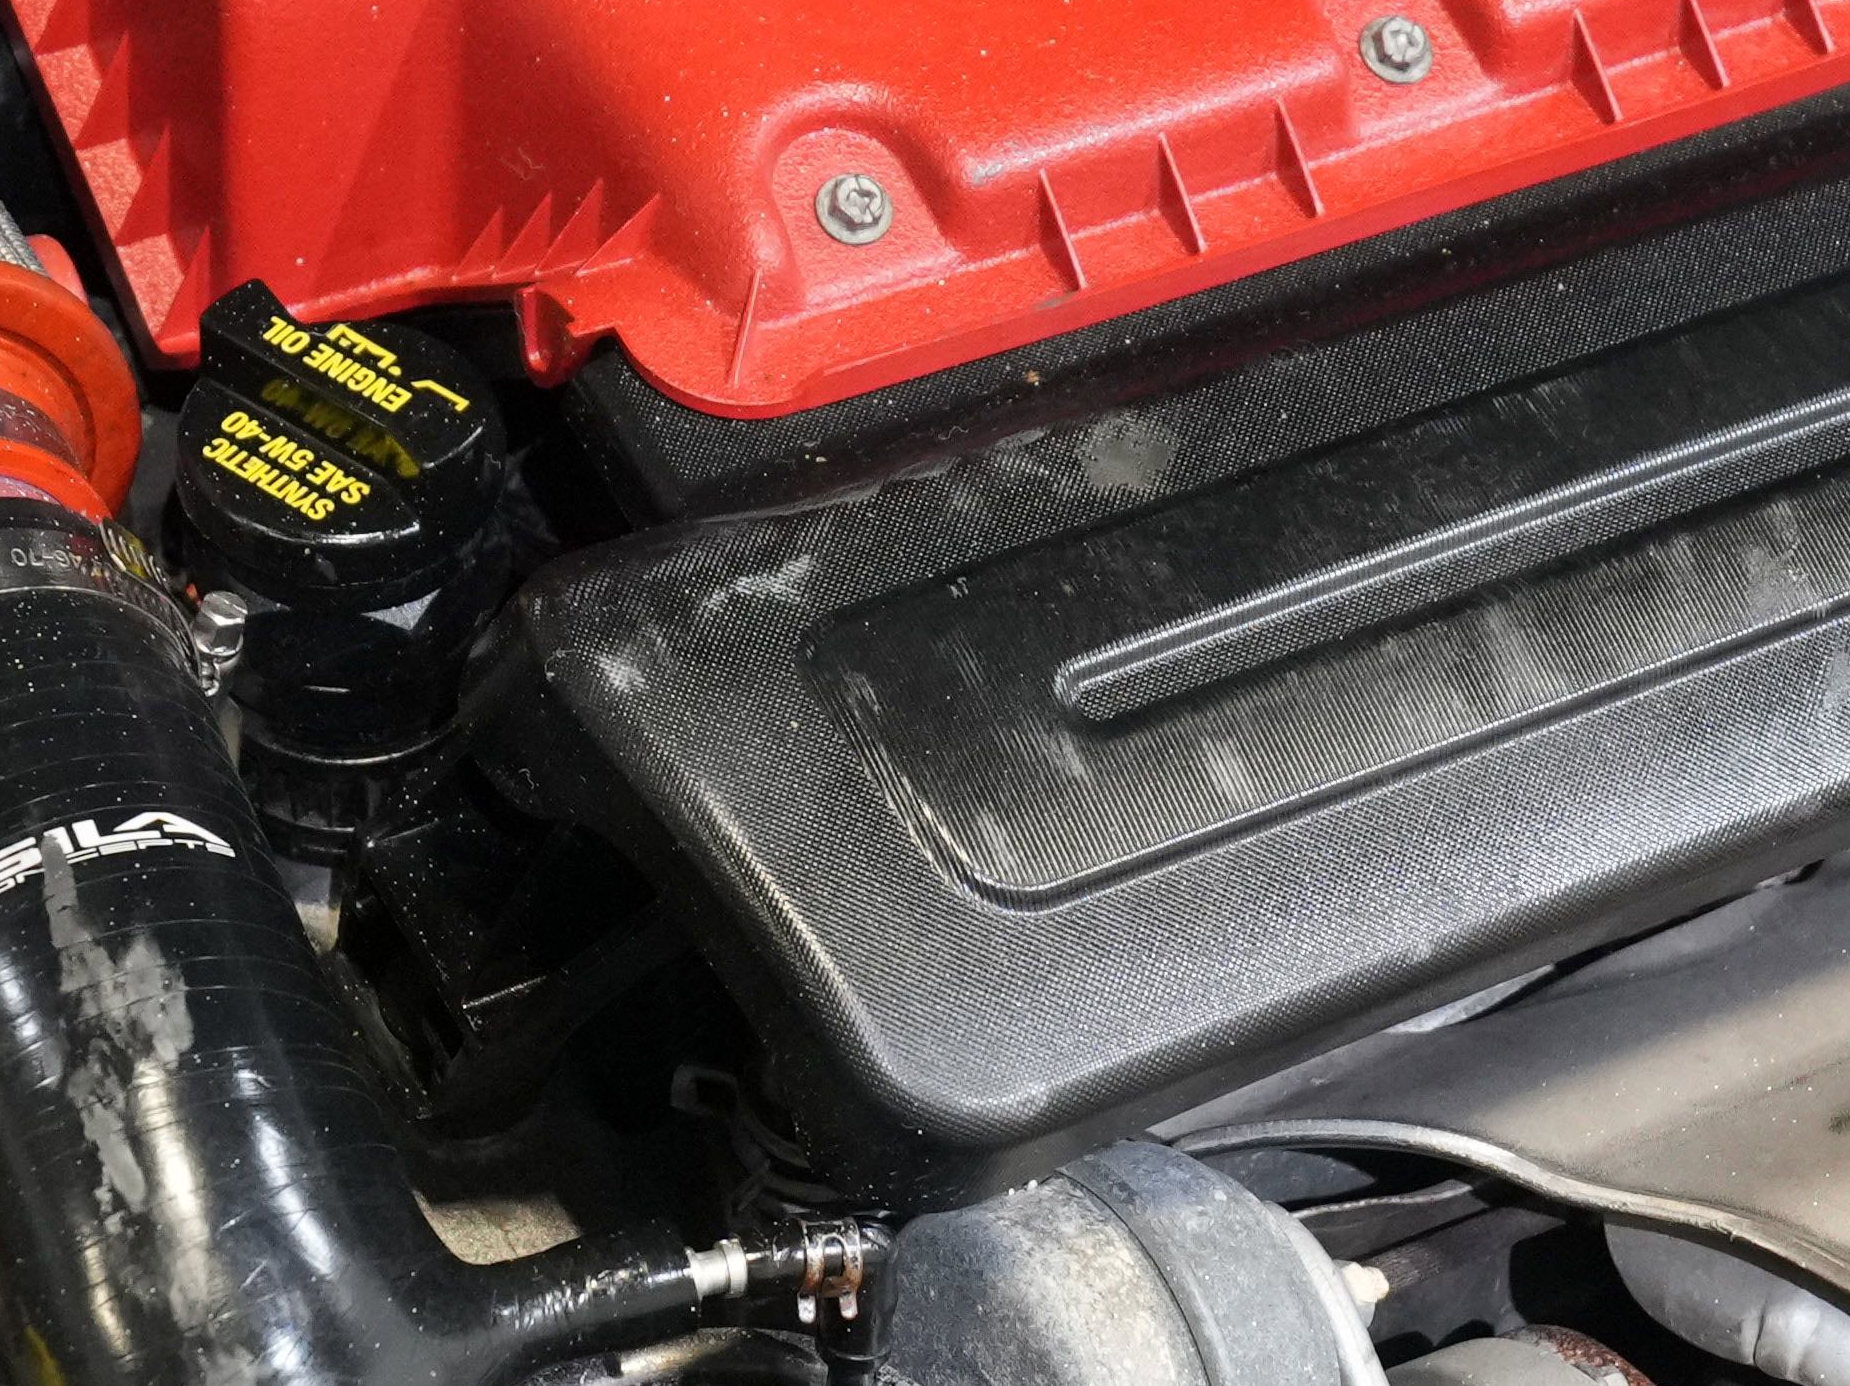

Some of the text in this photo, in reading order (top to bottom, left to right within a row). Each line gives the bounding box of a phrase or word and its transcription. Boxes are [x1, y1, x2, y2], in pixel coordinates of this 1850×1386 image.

[263, 316, 411, 412] ENGINE OIL
[201, 440, 335, 520] SYNTHETIC
[221, 411, 370, 504] SAE 5W-40
